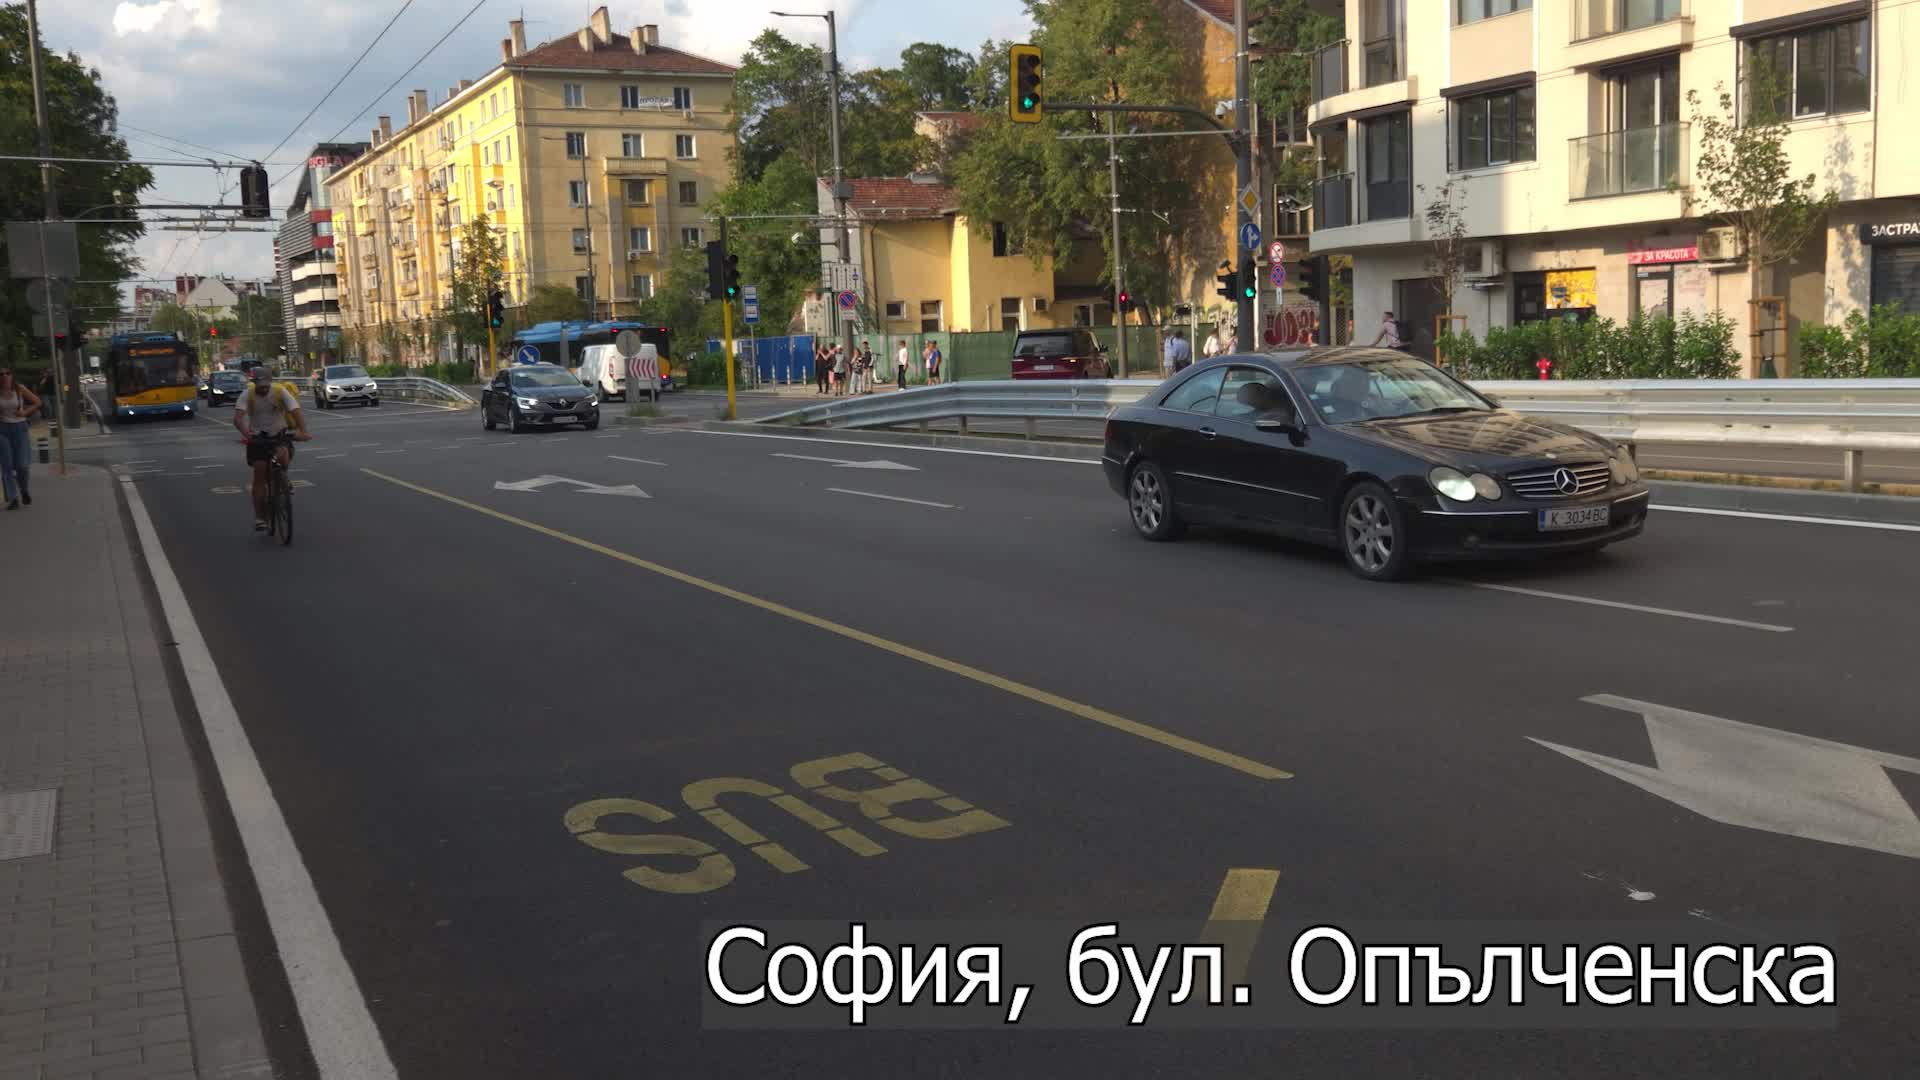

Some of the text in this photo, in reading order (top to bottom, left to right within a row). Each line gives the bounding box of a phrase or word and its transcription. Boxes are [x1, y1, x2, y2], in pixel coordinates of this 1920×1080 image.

[1872, 222, 1920, 237] ЗАСТРА
[1645, 248, 1689, 261] ЗА КРАСОТА
[564, 752, 1013, 893] BUS
